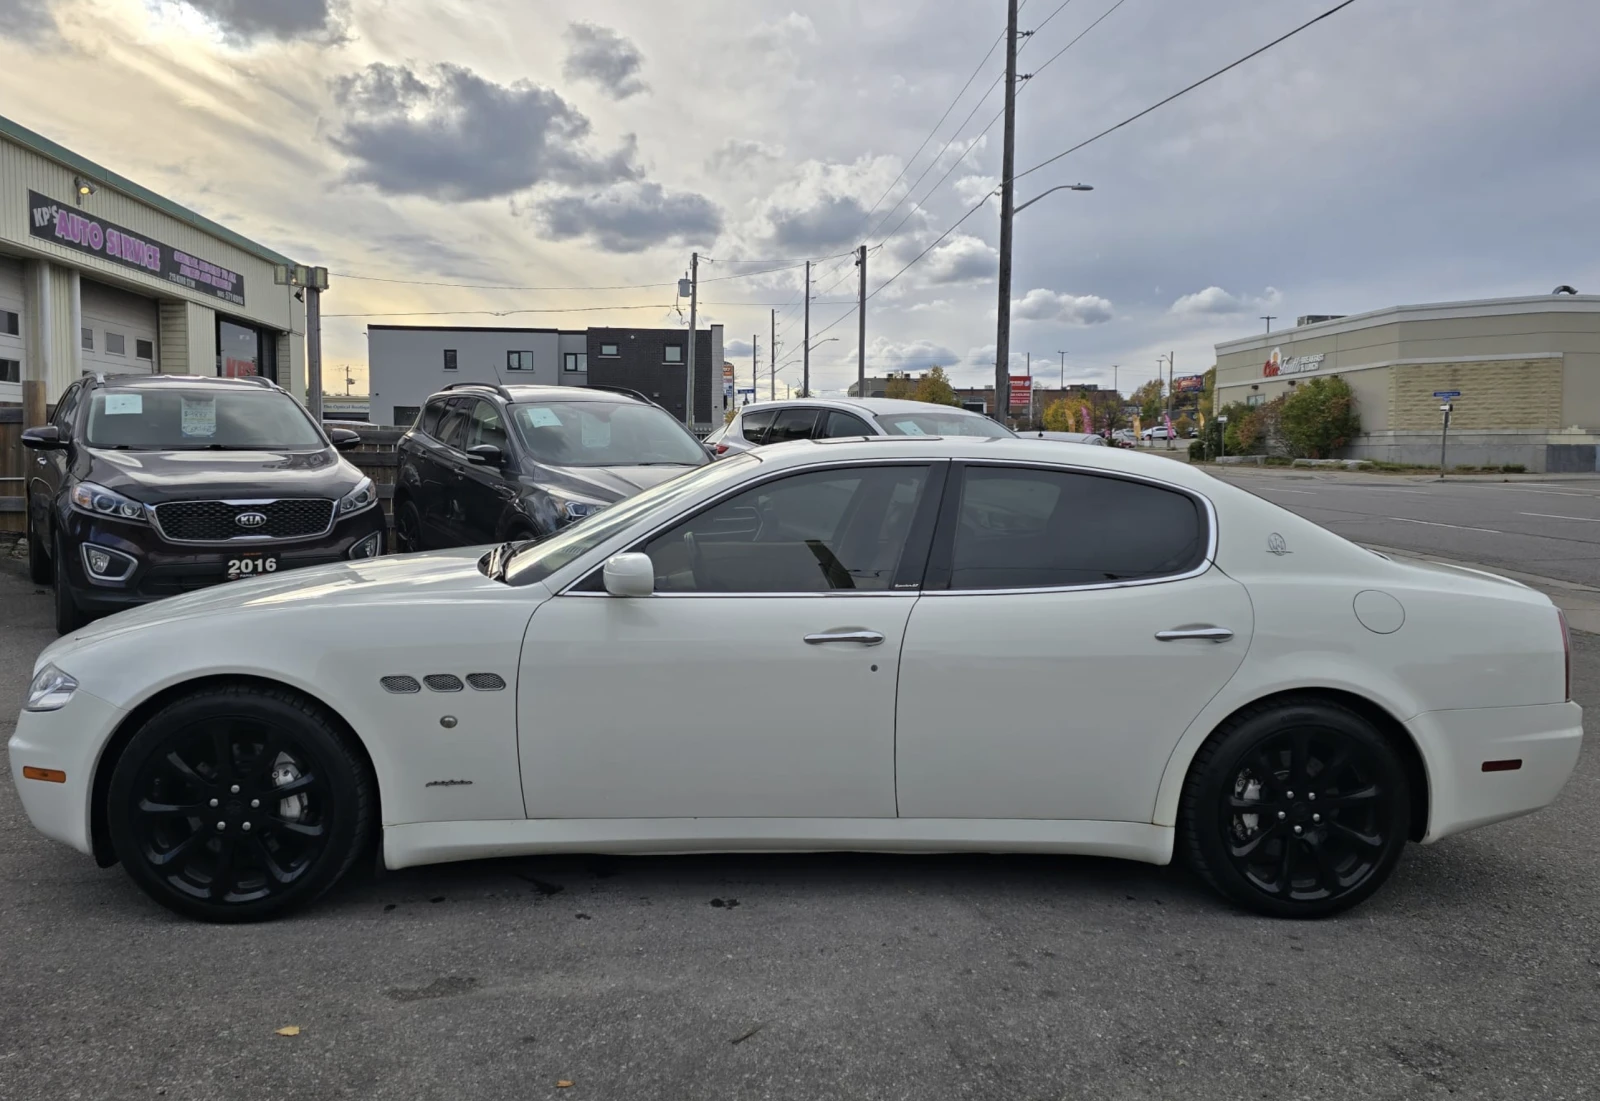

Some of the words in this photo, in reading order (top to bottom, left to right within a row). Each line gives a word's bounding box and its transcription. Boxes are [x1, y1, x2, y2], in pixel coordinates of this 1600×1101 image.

[55, 209, 103, 250] AUTO
[240, 515, 262, 525] KIA
[228, 557, 277, 574] 2016
